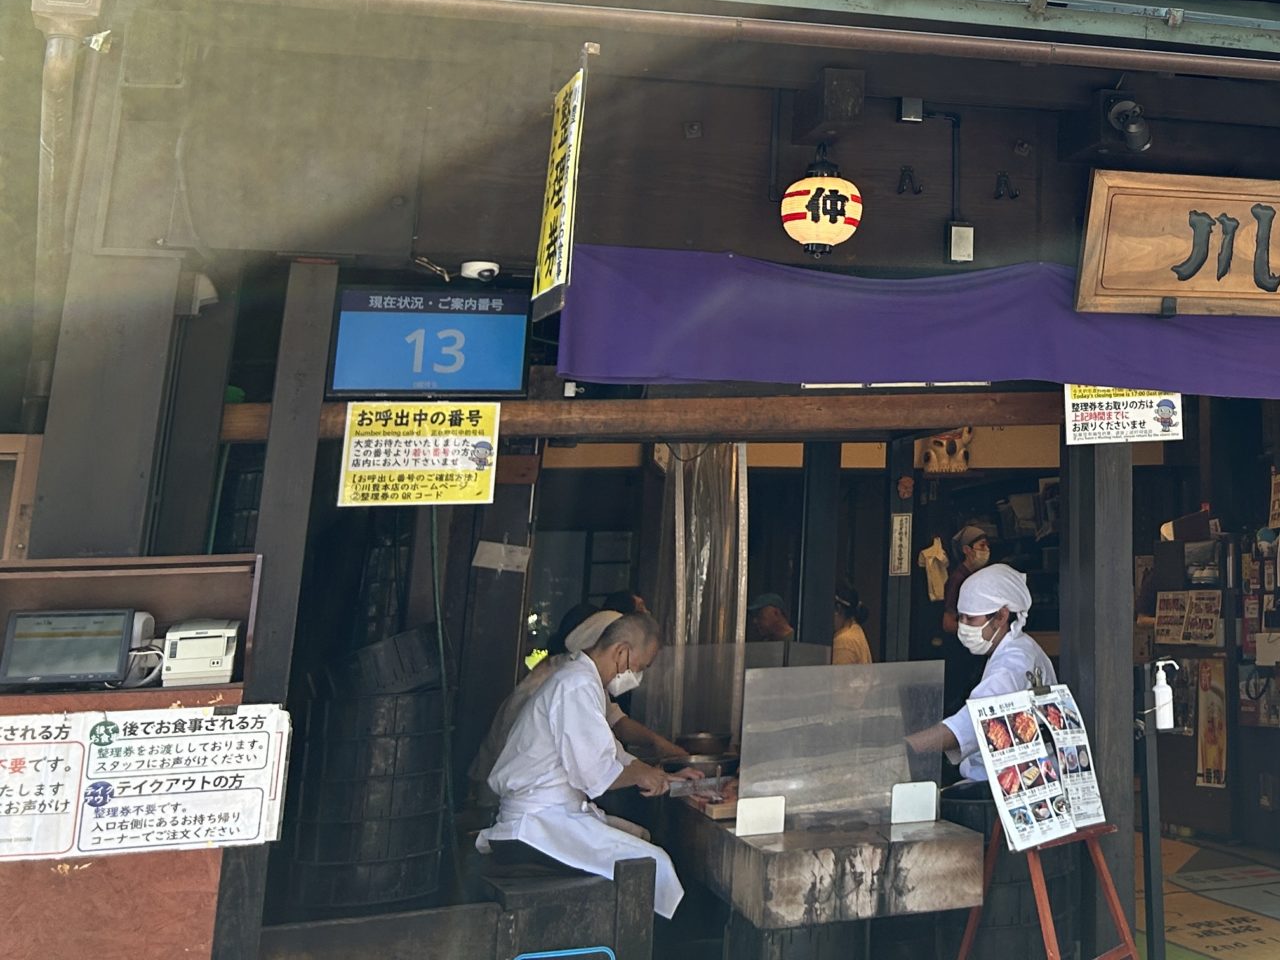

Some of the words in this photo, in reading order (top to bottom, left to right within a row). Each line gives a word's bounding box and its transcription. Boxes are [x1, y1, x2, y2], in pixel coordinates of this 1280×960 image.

[805, 187, 849, 224] 仲
[369, 295, 505, 312] 現在状況・ご案内番号
[405, 328, 466, 374] 13
[1072, 400, 1154, 412] 整理券をお取りの方は
[358, 409, 483, 427] お呼出中の番号
[1072, 420, 1147, 432] お戻りくださいませ
[122, 715, 267, 737] 後でお食事される方
[97, 739, 265, 759] 整理券をお渡ししております。
[95, 753, 258, 772] スタッフにお声がけください
[116, 774, 245, 796] テイクアウトの方
[93, 802, 187, 819] 整理券不要です。
[91, 813, 241, 833] 入口右側にあるお持ち帰り
[91, 826, 241, 846] コーナーでご注文ください
